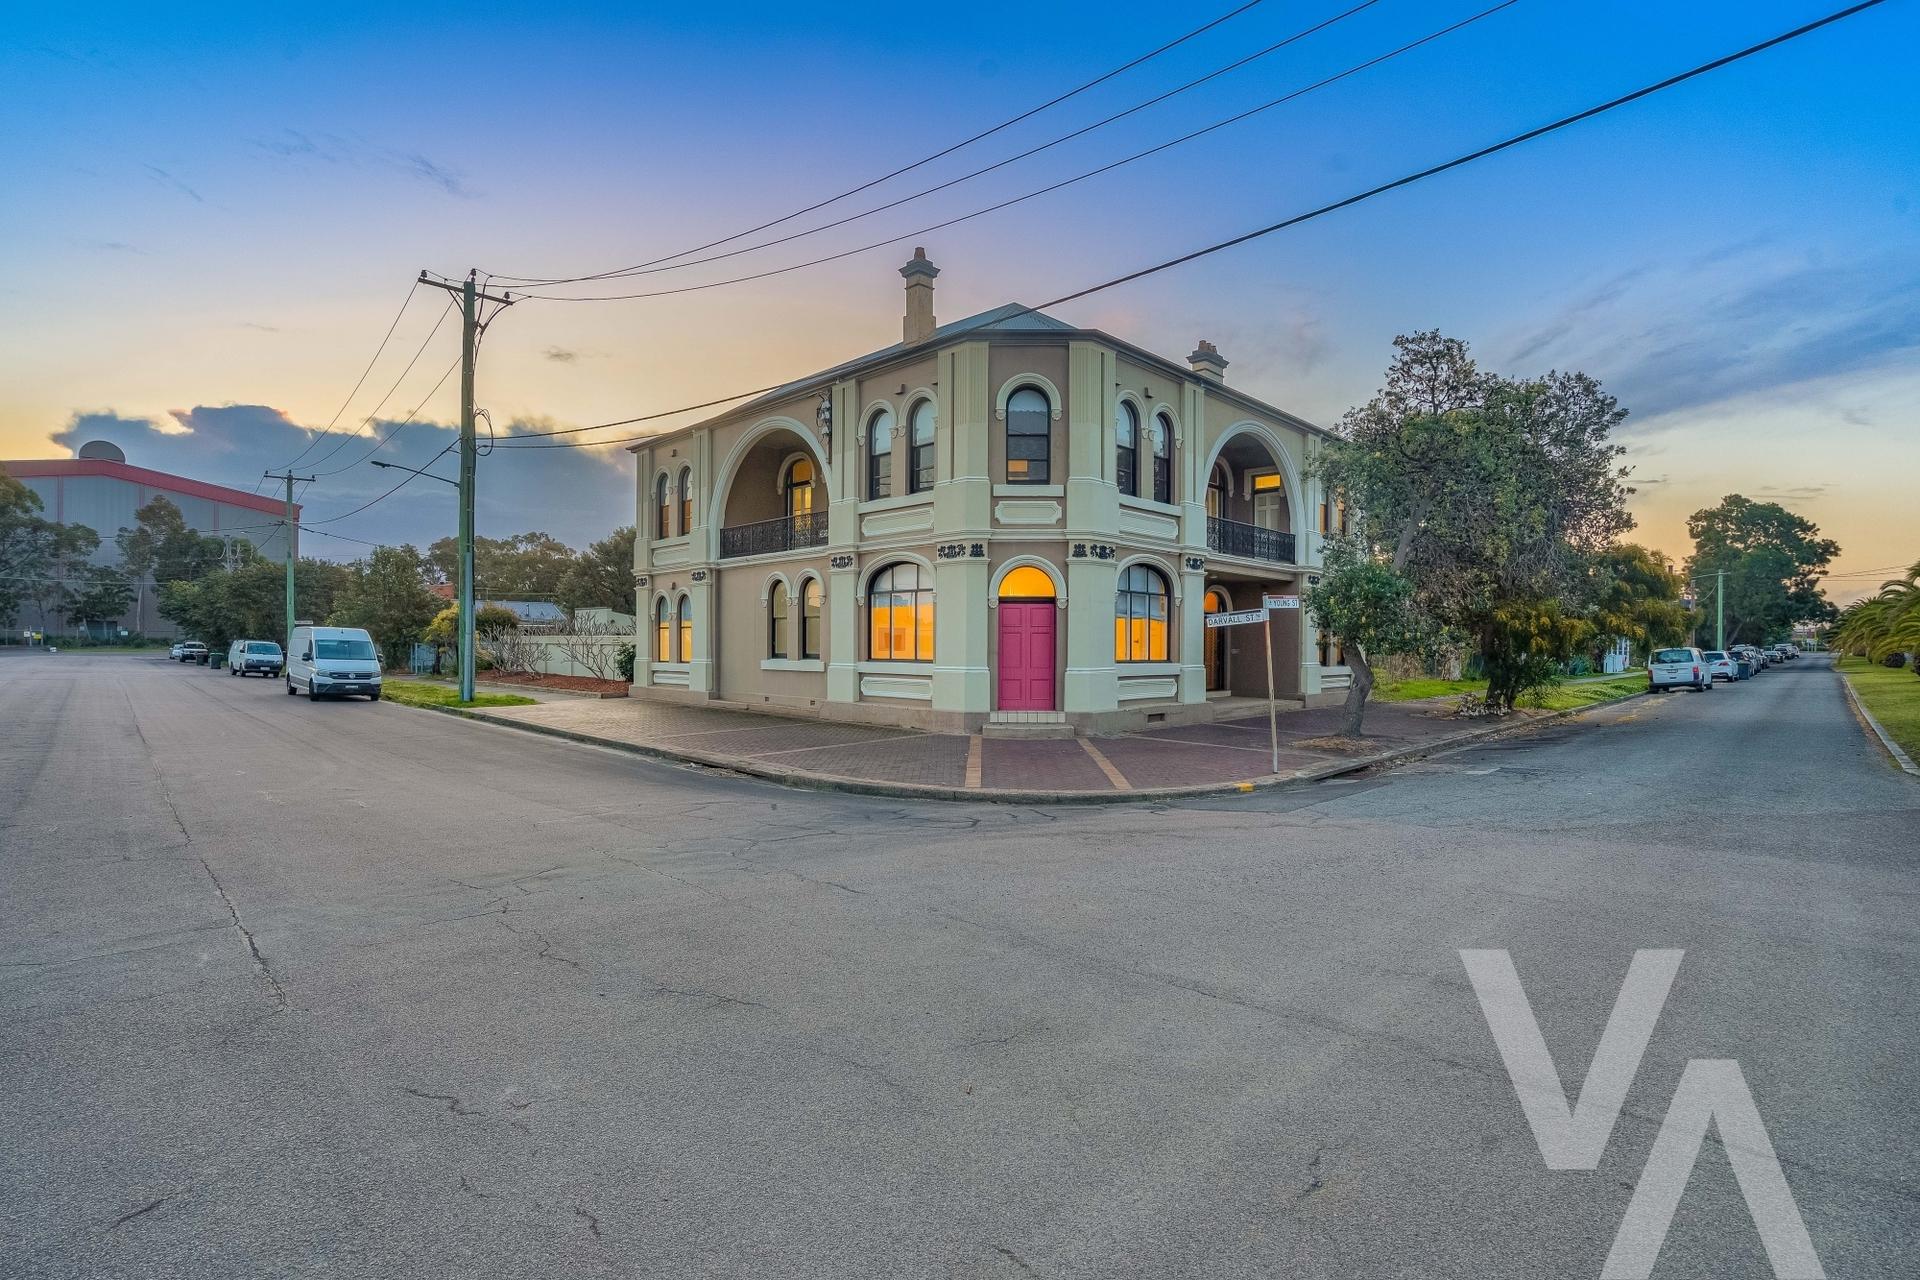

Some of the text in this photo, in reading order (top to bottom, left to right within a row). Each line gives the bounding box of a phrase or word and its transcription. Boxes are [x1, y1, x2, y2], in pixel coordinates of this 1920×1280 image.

[1274, 599, 1290, 607] YOUNG
[1292, 599, 1298, 607] ST
[1208, 616, 1242, 626] DARVALL
[1245, 614, 1255, 622] ST
